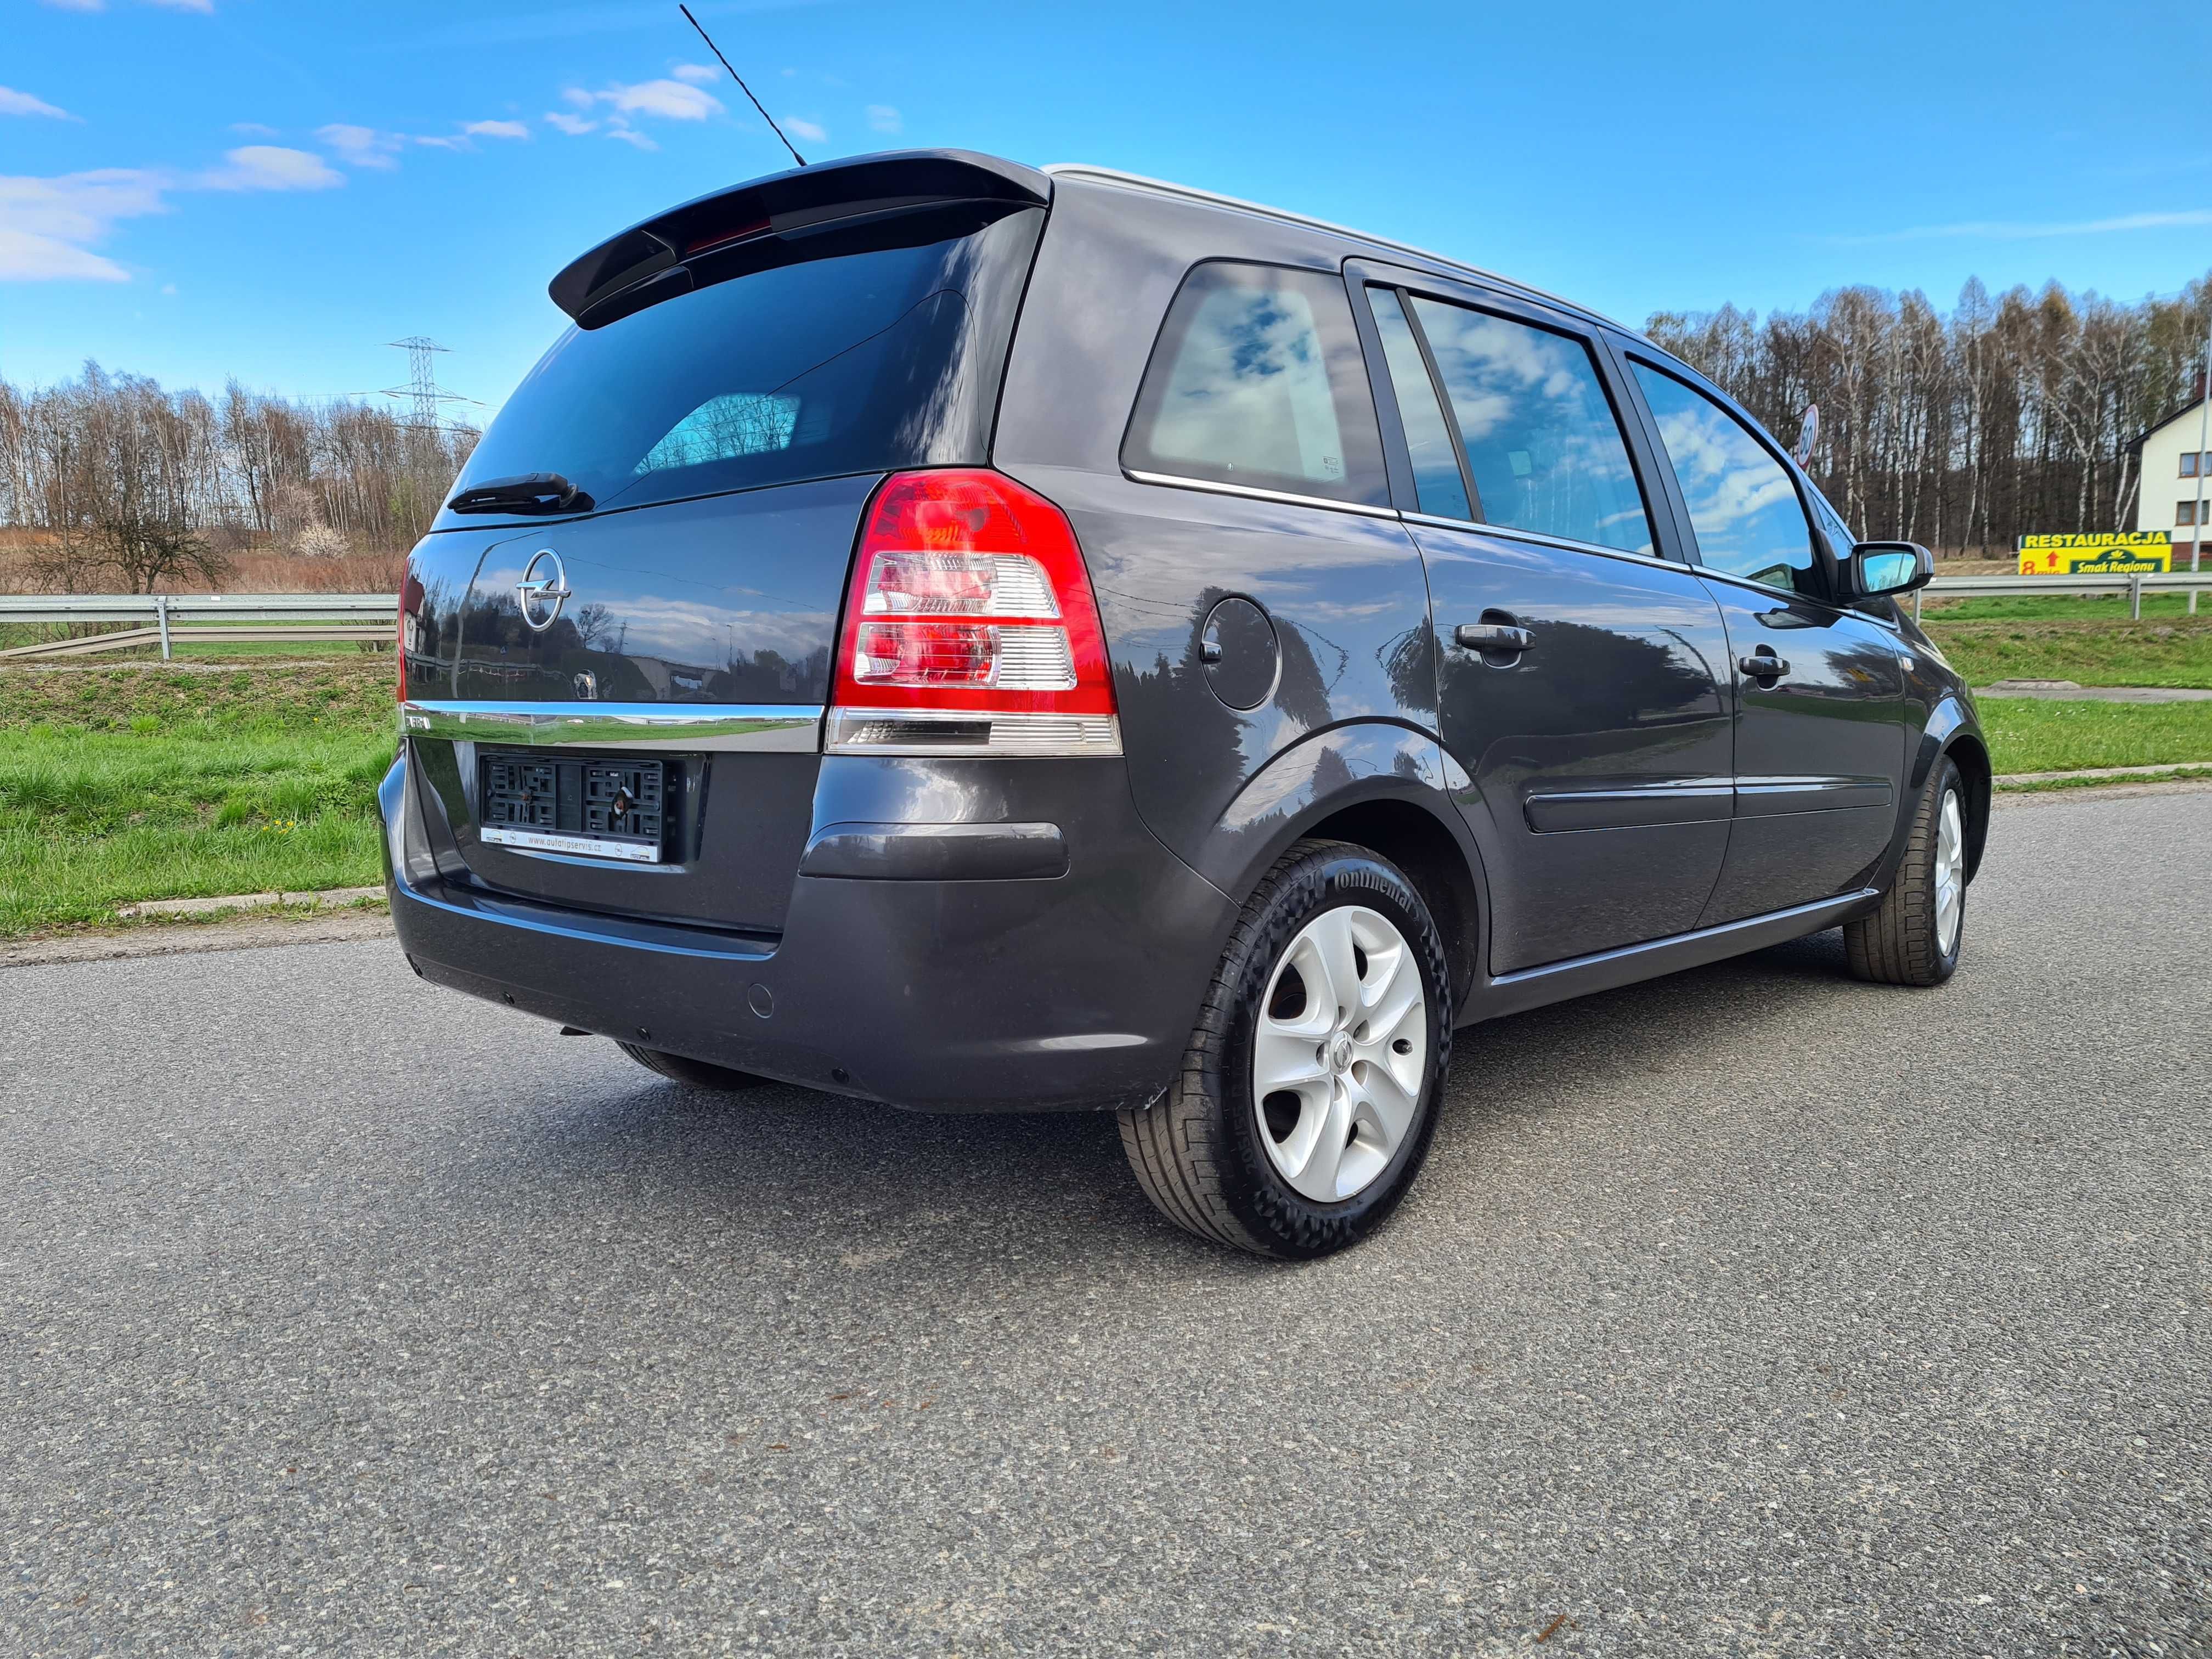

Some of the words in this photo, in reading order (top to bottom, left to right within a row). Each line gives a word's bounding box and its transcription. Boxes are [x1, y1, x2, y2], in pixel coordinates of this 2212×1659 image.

[1800, 425, 1813, 455] 60
[2025, 531, 2167, 548] RESTAURACJA
[2076, 561, 2108, 574] Smak
[2108, 561, 2155, 574] Regionu
[1334, 867, 1413, 913] Continental
